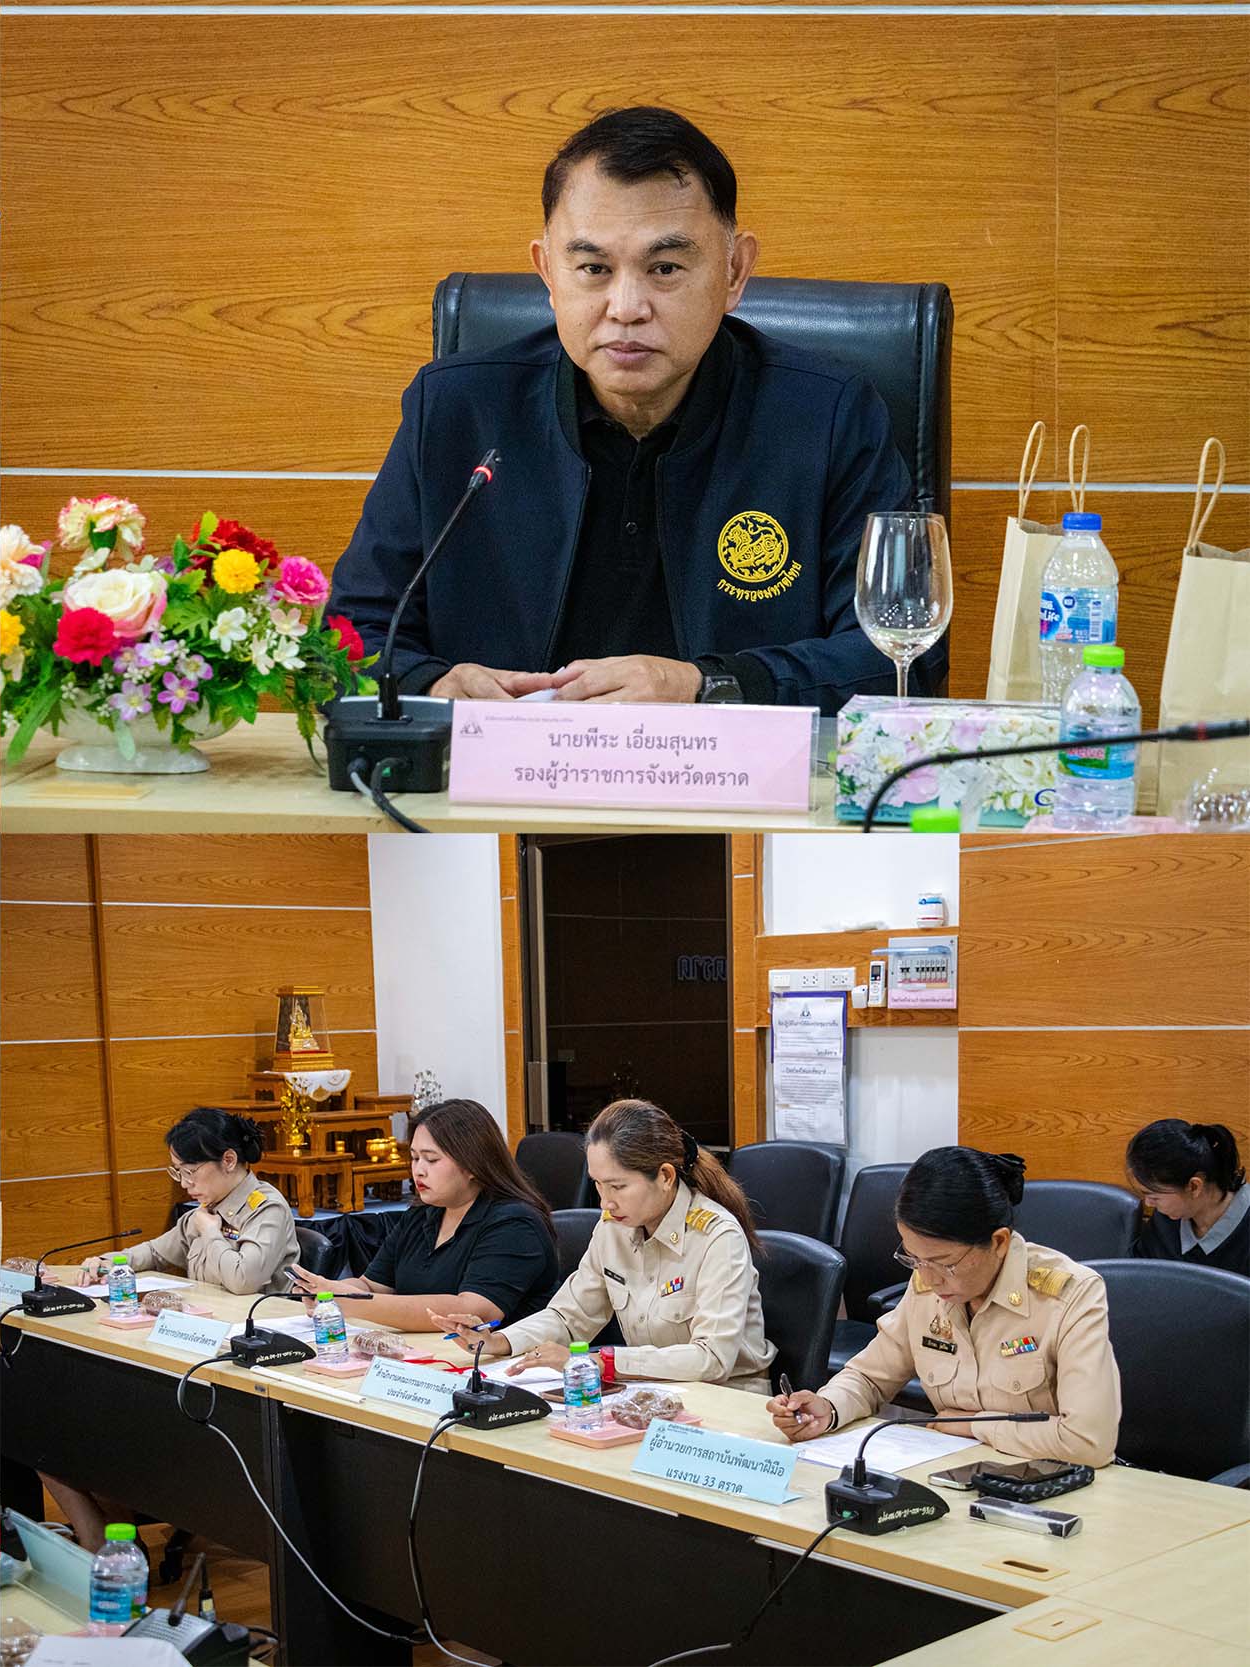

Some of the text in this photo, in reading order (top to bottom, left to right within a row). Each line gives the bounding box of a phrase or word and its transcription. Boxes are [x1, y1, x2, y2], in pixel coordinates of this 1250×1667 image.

[548, 723, 718, 757] นายพีระ เอี่ยมสุนทร
[514, 760, 749, 789] รองผู้ว่าราชการจังหวัดตราด
[376, 1368, 457, 1394] สำนักงานคณะกรรมการการเลือกตั้
[650, 1435, 785, 1477] ผู้อำนวยการสถาบันพัฒนาฝีมือ
[666, 1467, 742, 1494] แรงงาน 33 ตราด
